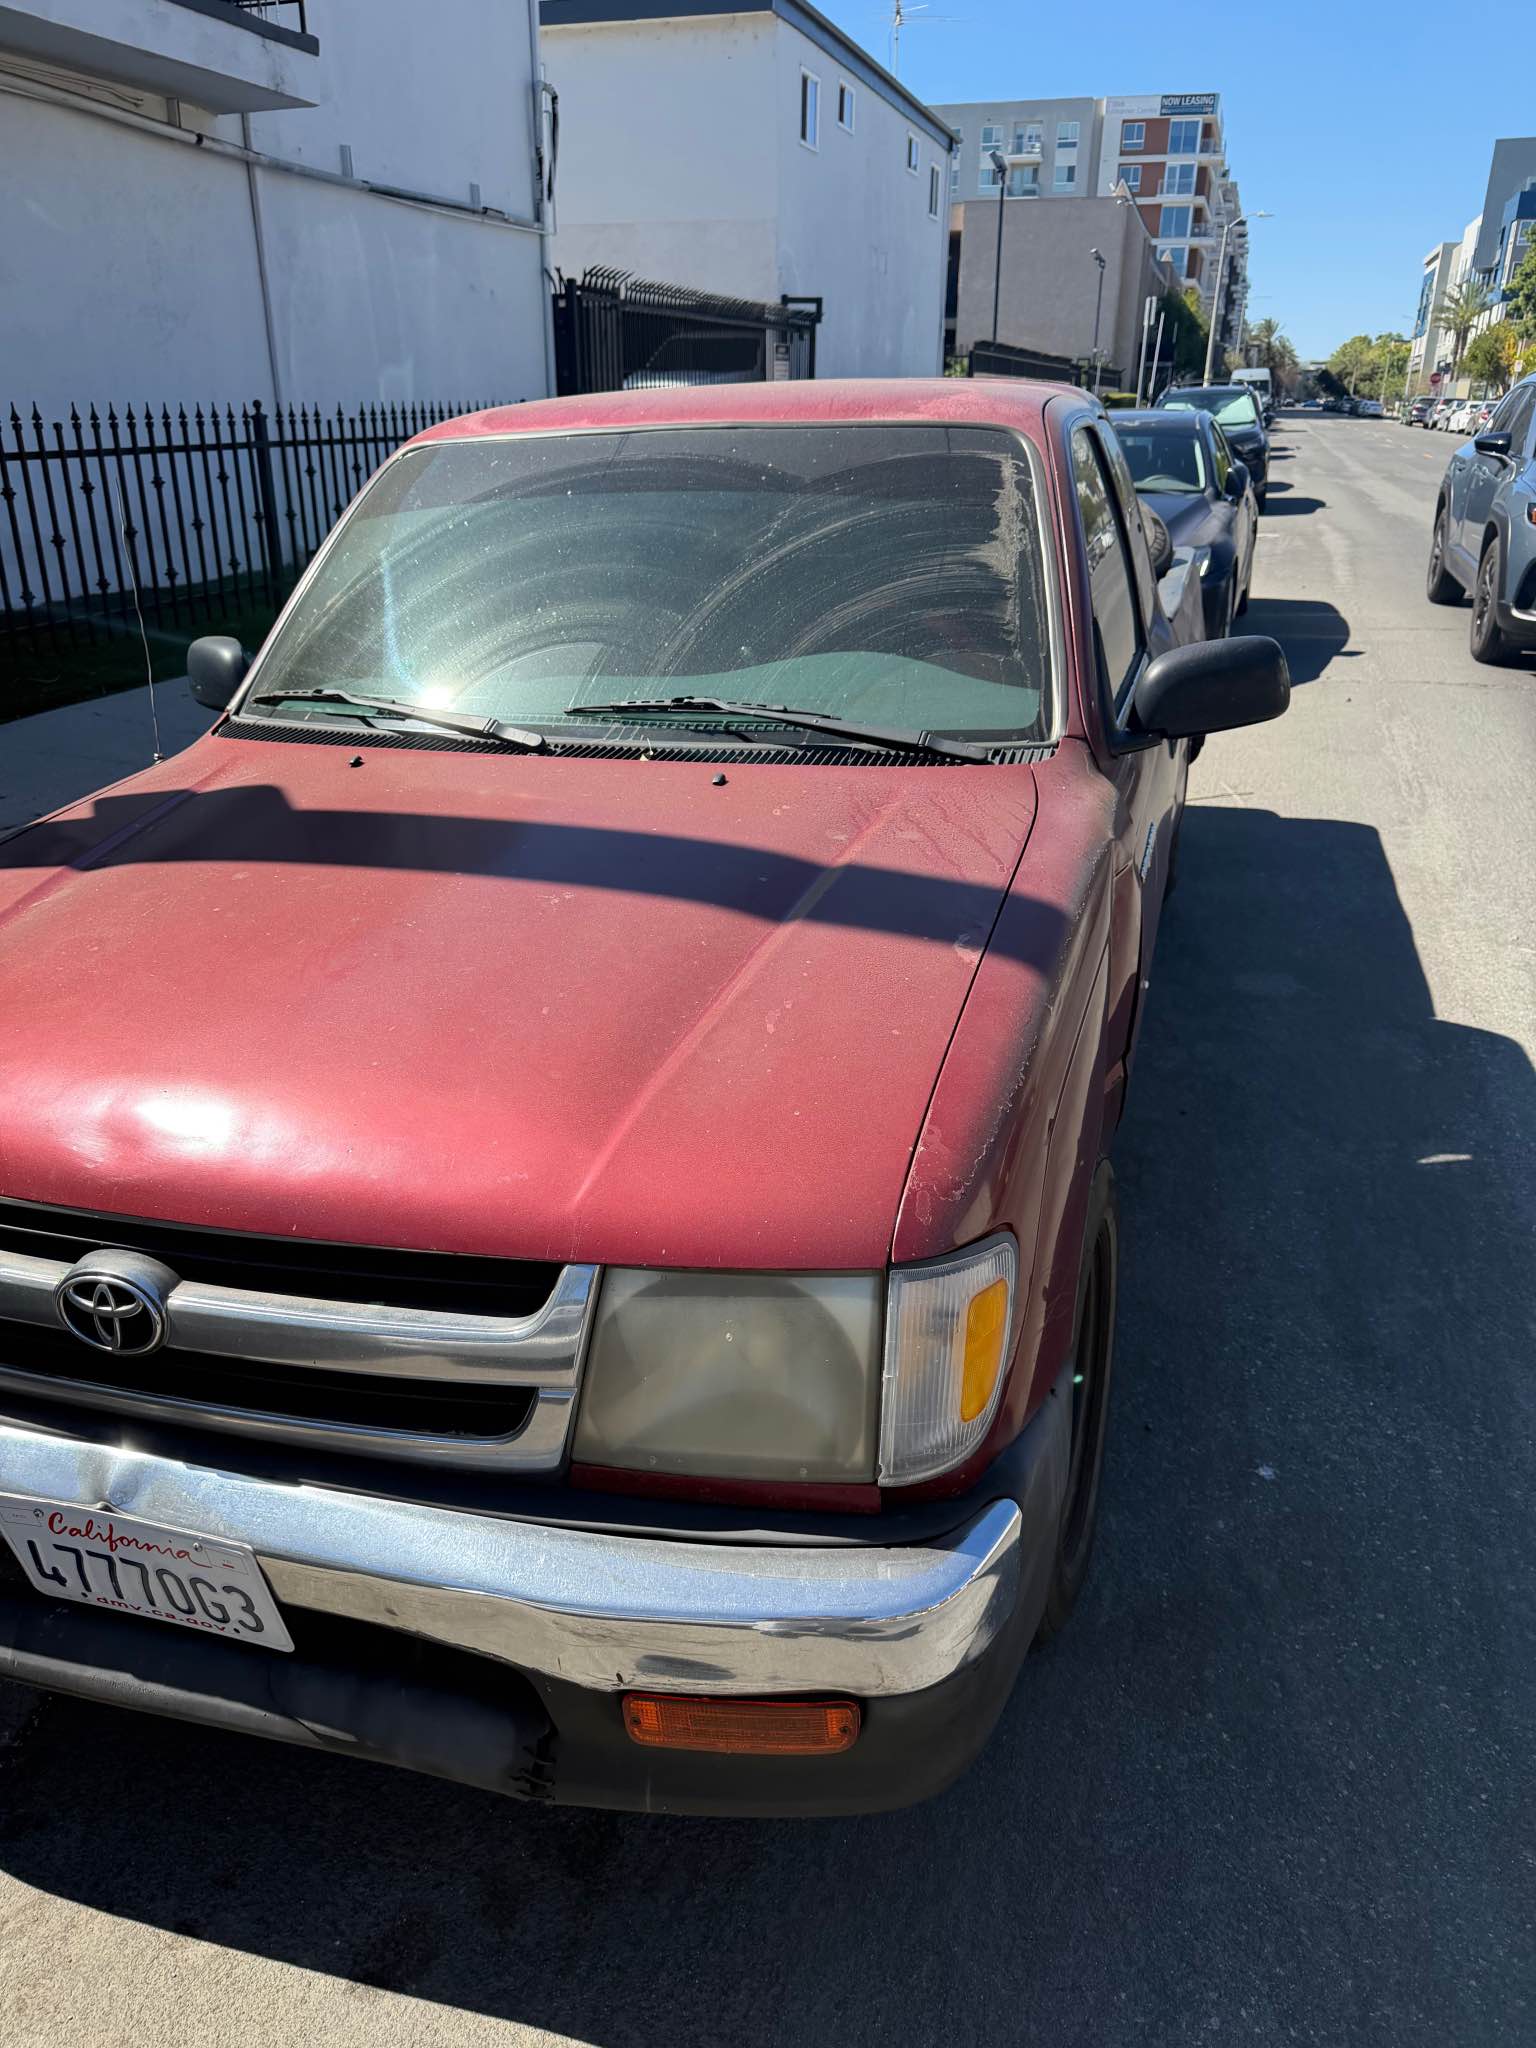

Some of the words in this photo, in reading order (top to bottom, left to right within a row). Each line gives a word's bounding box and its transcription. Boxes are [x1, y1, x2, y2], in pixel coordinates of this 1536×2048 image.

[1162, 96, 1181, 106] NOW
[1181, 95, 1215, 106] LEASING
[48, 1511, 212, 1568] California
[27, 1539, 265, 1633] 47770G3
